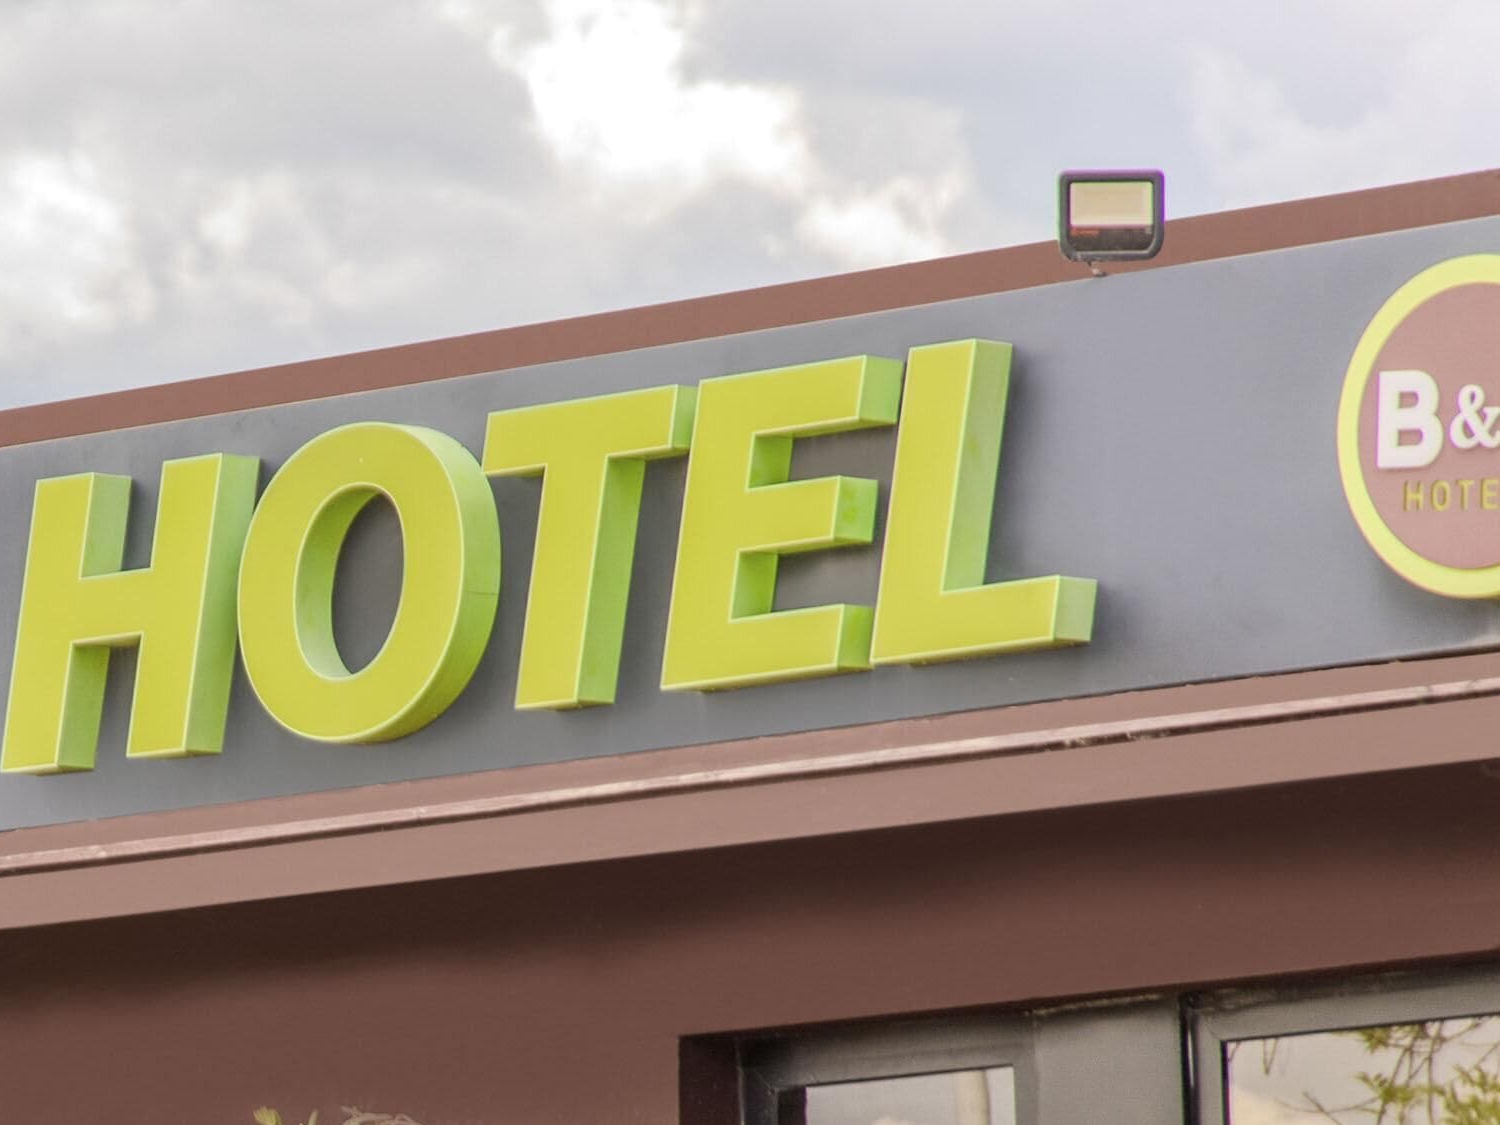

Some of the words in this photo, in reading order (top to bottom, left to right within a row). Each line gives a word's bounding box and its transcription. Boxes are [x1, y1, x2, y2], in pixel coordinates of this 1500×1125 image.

[1377, 370, 1500, 468] B&
[1403, 478, 1500, 512] HOTE
[0, 338, 1097, 774] HOTEL
